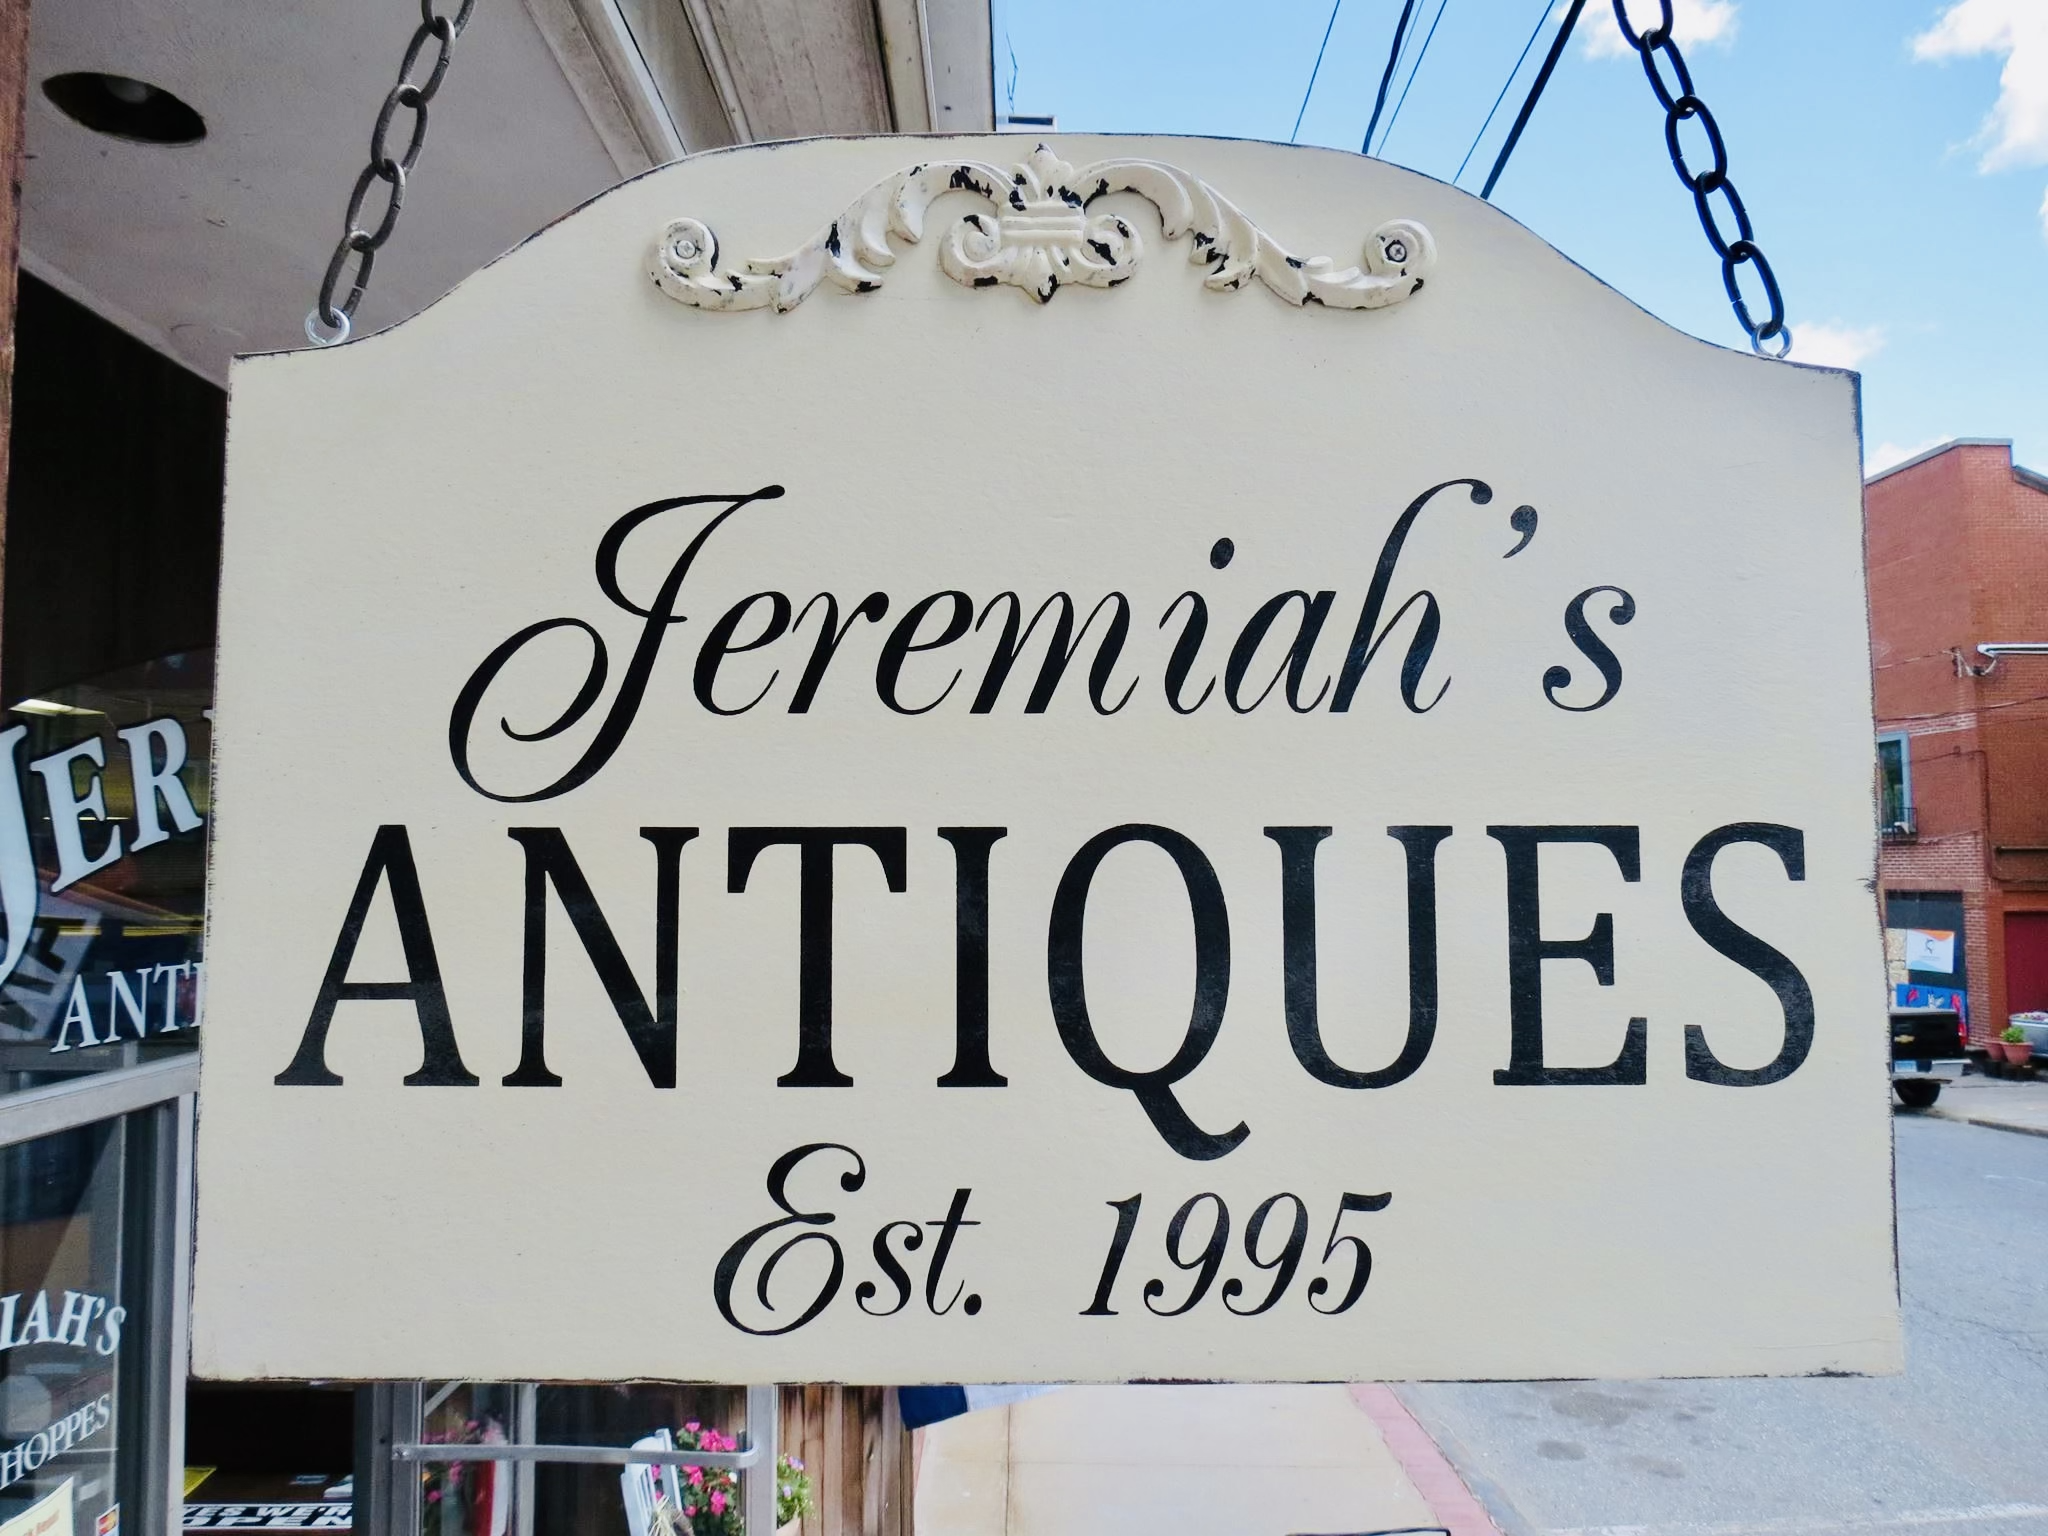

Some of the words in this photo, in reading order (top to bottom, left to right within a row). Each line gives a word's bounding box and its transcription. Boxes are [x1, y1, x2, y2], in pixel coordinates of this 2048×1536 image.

[448, 478, 1636, 801] Jeremiah's
[0, 708, 212, 987] JER
[273, 821, 1816, 1162] ANTIQUES
[713, 1142, 982, 1337] Est.
[1078, 1191, 1393, 1317] 1995
